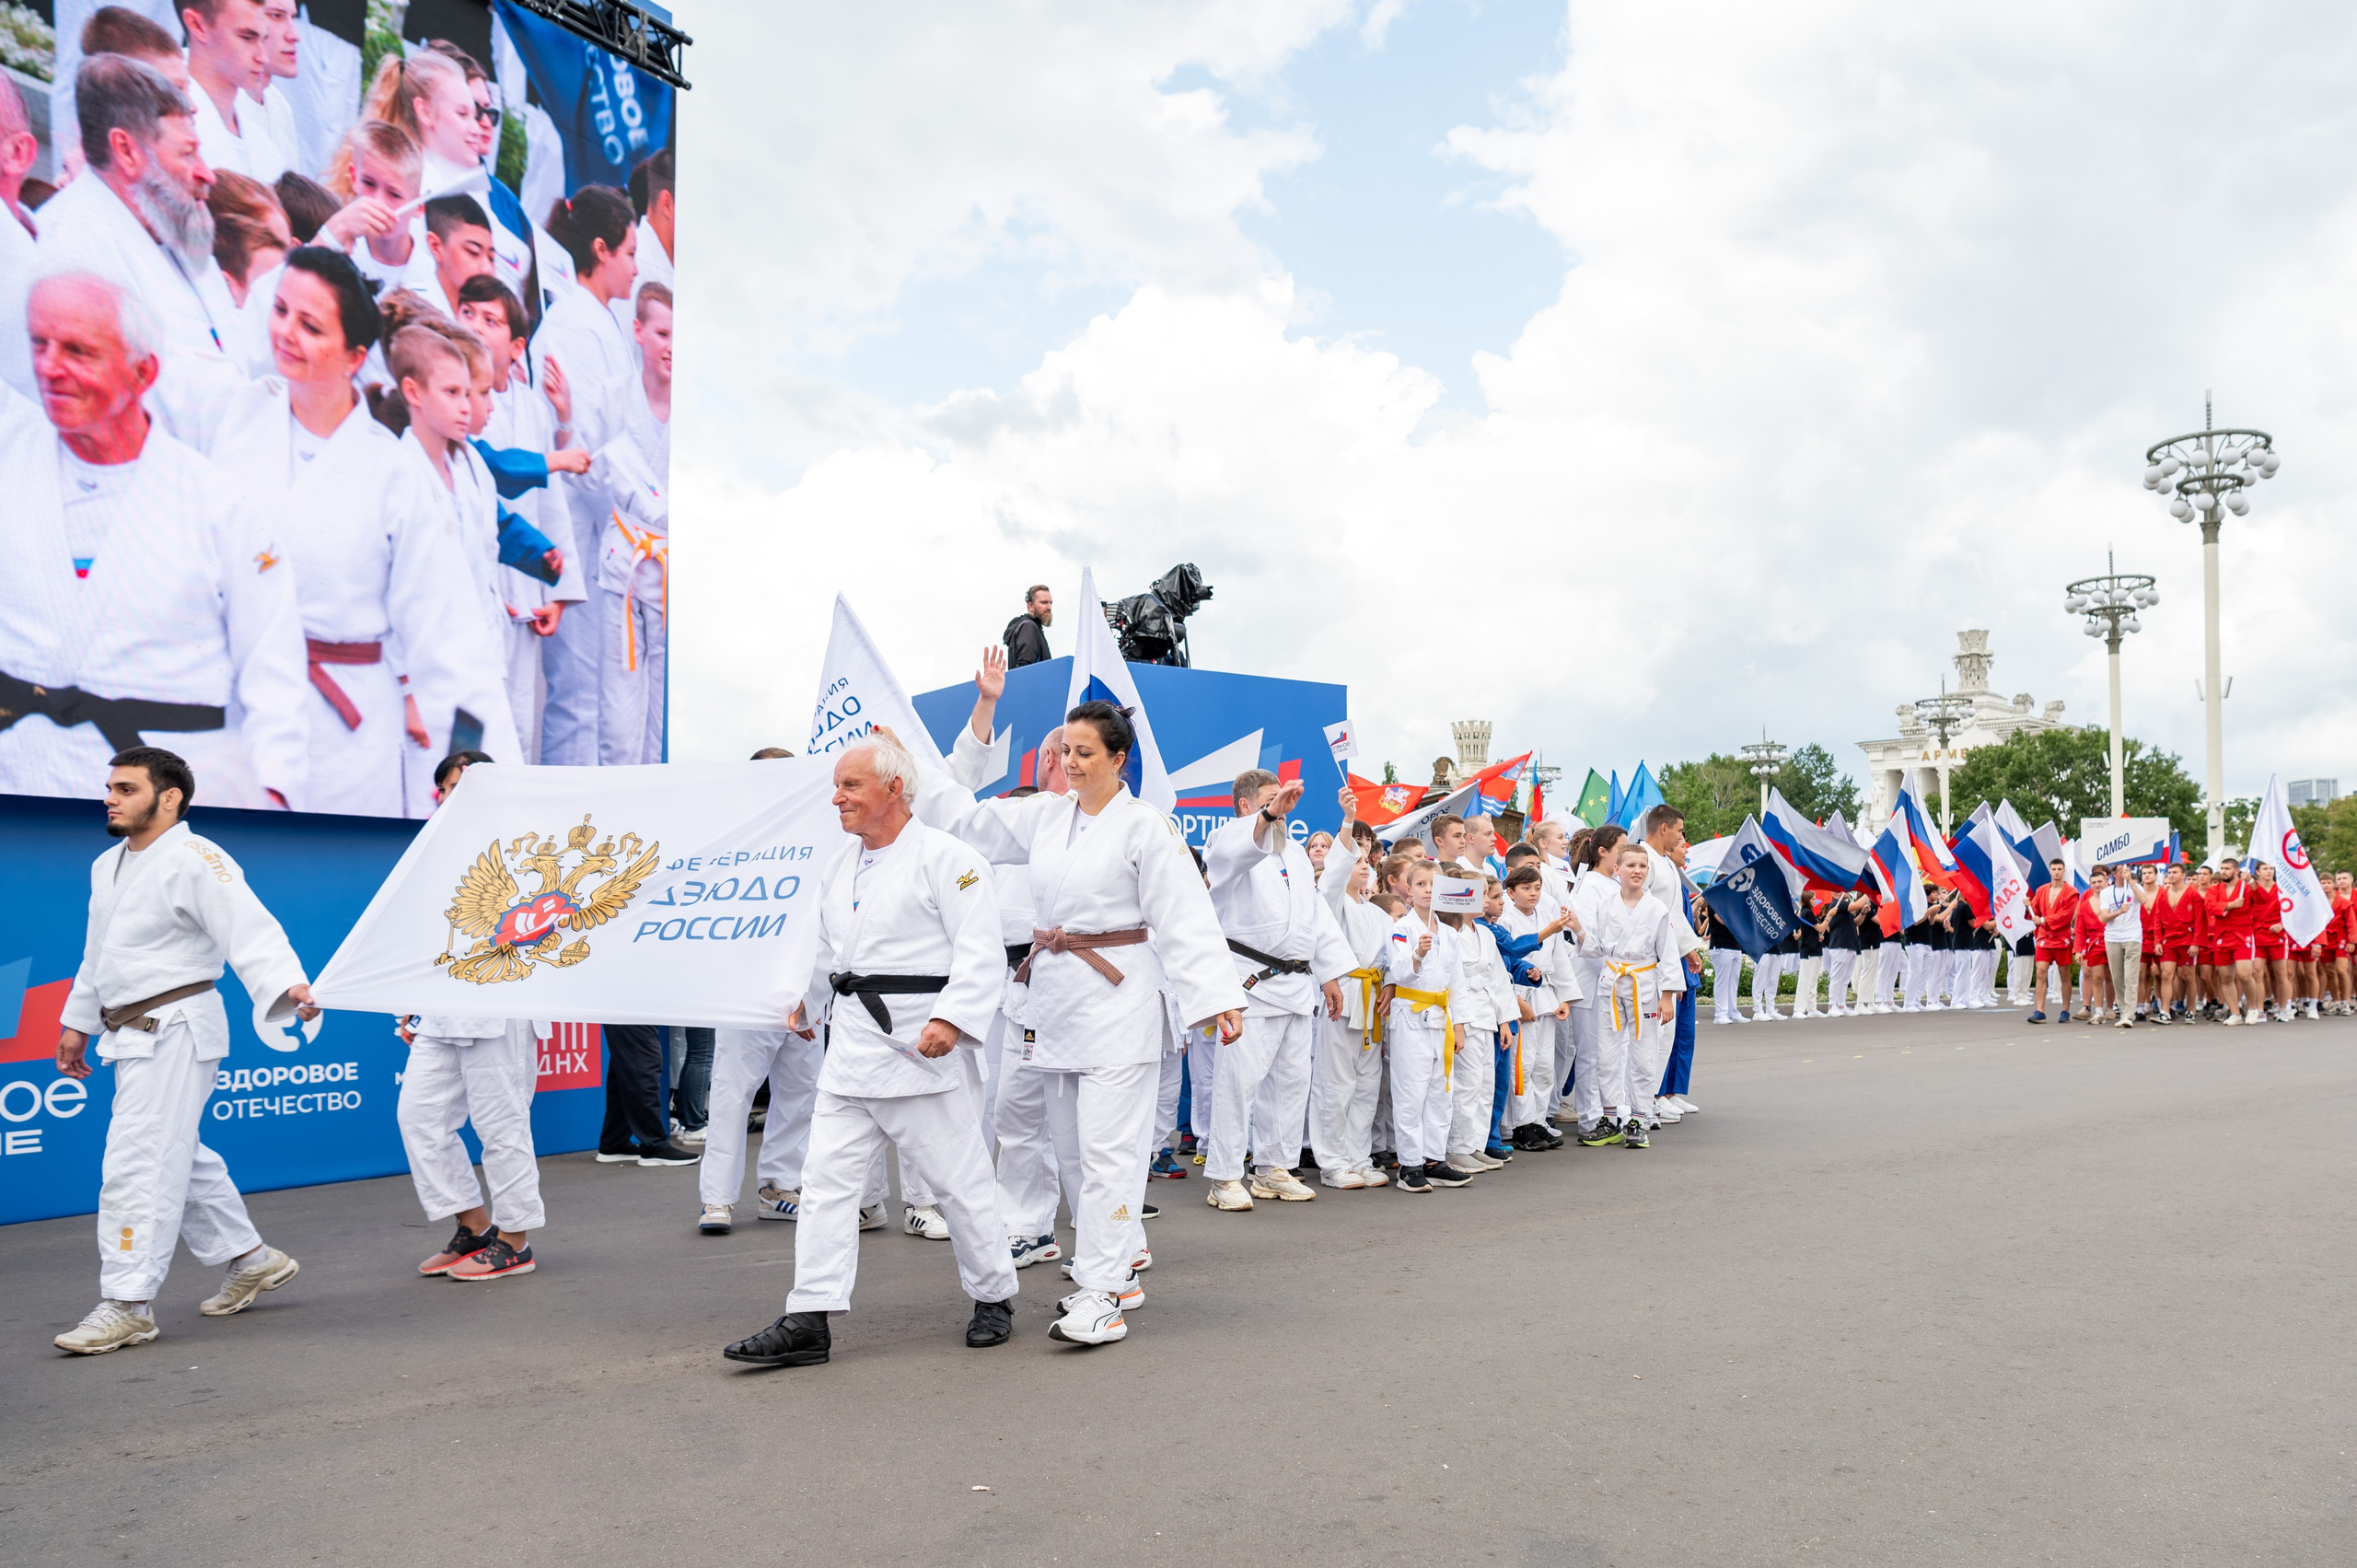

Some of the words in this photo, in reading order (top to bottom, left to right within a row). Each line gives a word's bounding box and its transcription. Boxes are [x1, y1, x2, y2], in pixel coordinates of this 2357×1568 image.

[666, 845, 814, 872] ФЕЕРАЦИЯ
[2096, 832, 2130, 861] САМБО
[647, 875, 801, 907] ДЗЮДО
[1745, 896, 1779, 939] ОТЕЧЕСТВО
[1751, 885, 1787, 930] ЗДОРОВОЕ
[632, 912, 788, 944] РОССИИ
[215, 1062, 359, 1093] ЗДОРОВОЕ
[537, 1051, 589, 1076] ДНХ
[212, 1090, 362, 1121] ОТЕЧЕСТВО
